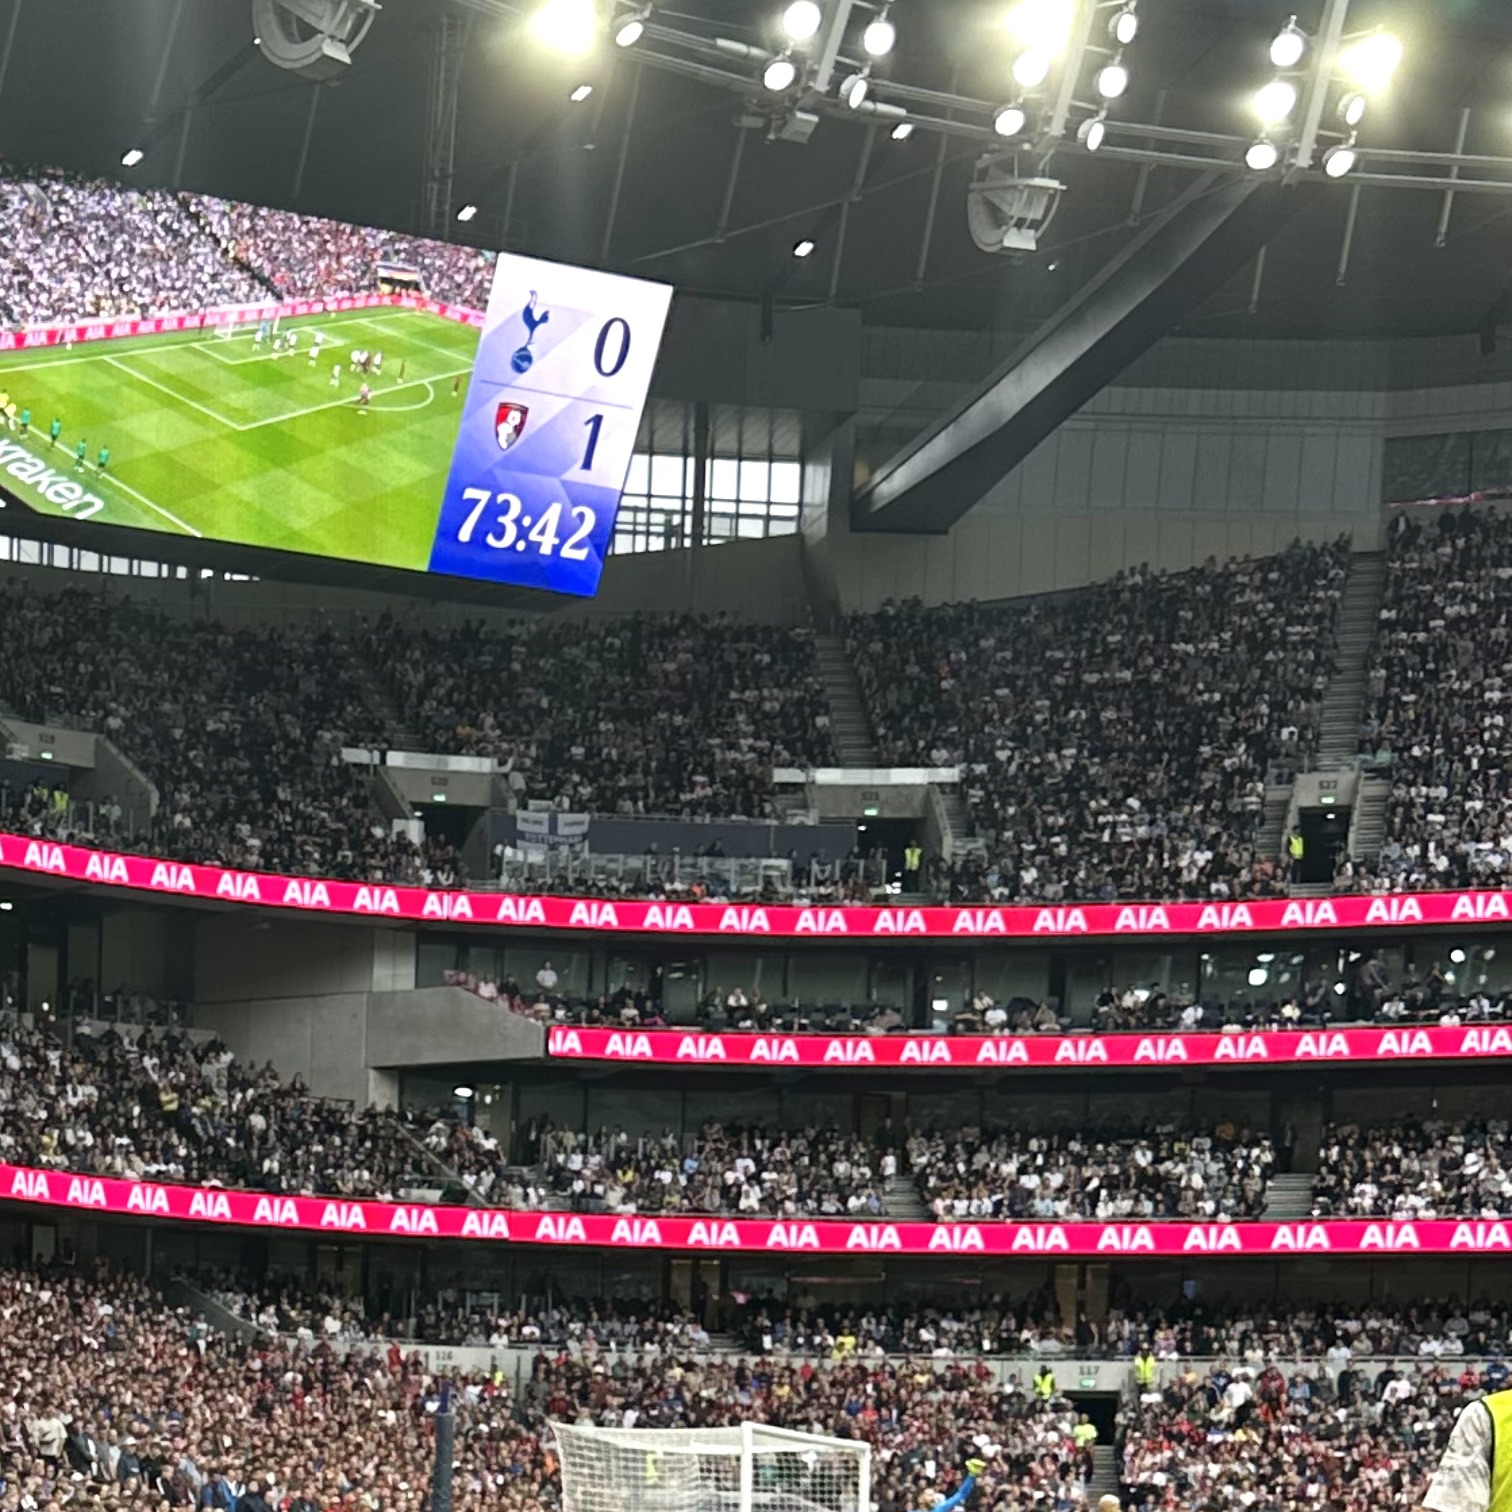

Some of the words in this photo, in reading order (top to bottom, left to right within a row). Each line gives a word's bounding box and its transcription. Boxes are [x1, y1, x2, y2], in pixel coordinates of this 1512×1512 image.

[594, 317, 631, 378] 0
[580, 413, 604, 471] 1
[457, 487, 597, 561] 73:42
[23, 841, 66, 872] AIA
[85, 852, 128, 883] AIA
[150, 862, 195, 891] AIA
[216, 871, 260, 900] AIA
[282, 879, 330, 907] AIA
[352, 886, 399, 913] AIA
[421, 892, 472, 918] AIA
[496, 896, 545, 923] AIA
[569, 900, 618, 927] AIA
[642, 904, 694, 929] AIA
[718, 906, 770, 931] AIA
[794, 908, 847, 933] AIA
[873, 908, 926, 933] AIA
[952, 908, 1006, 933] AIA
[1032, 907, 1087, 932] AIA
[1114, 905, 1169, 931] AIA
[1196, 903, 1253, 929] AIA
[1280, 900, 1337, 926] AIA
[1365, 896, 1422, 923] AIA
[1451, 893, 1509, 920] AIA
[604, 1032, 652, 1058] AIA
[676, 1035, 726, 1059] AIA
[749, 1037, 799, 1061] AIA
[823, 1038, 874, 1063] AIA
[899, 1038, 951, 1063] AIA
[976, 1038, 1028, 1063] AIA
[1054, 1038, 1107, 1062] AIA
[1133, 1037, 1187, 1061] AIA
[1213, 1035, 1268, 1059] AIA
[1294, 1032, 1349, 1057] AIA
[1376, 1030, 1432, 1055] AIA
[1460, 1027, 1512, 1052] AIA
[11, 1169, 49, 1199] AIA
[67, 1176, 106, 1206] AIA
[126, 1184, 169, 1212] AIA
[188, 1191, 231, 1219] AIA
[253, 1196, 299, 1224] AIA
[320, 1202, 366, 1228] AIA
[389, 1206, 438, 1234] AIA
[460, 1210, 509, 1238] AIA
[535, 1215, 586, 1242] AIA
[610, 1218, 661, 1244] AIA
[687, 1221, 740, 1247] AIA
[766, 1222, 819, 1248] AIA
[845, 1224, 901, 1250] AIA
[928, 1224, 984, 1250] AIA
[1011, 1225, 1069, 1250] AIA
[1096, 1225, 1154, 1250] AIA
[1183, 1224, 1242, 1250] AIA
[1270, 1224, 1330, 1250] AIA
[1359, 1222, 1420, 1250] AIA
[1449, 1221, 1511, 1248] AIA
